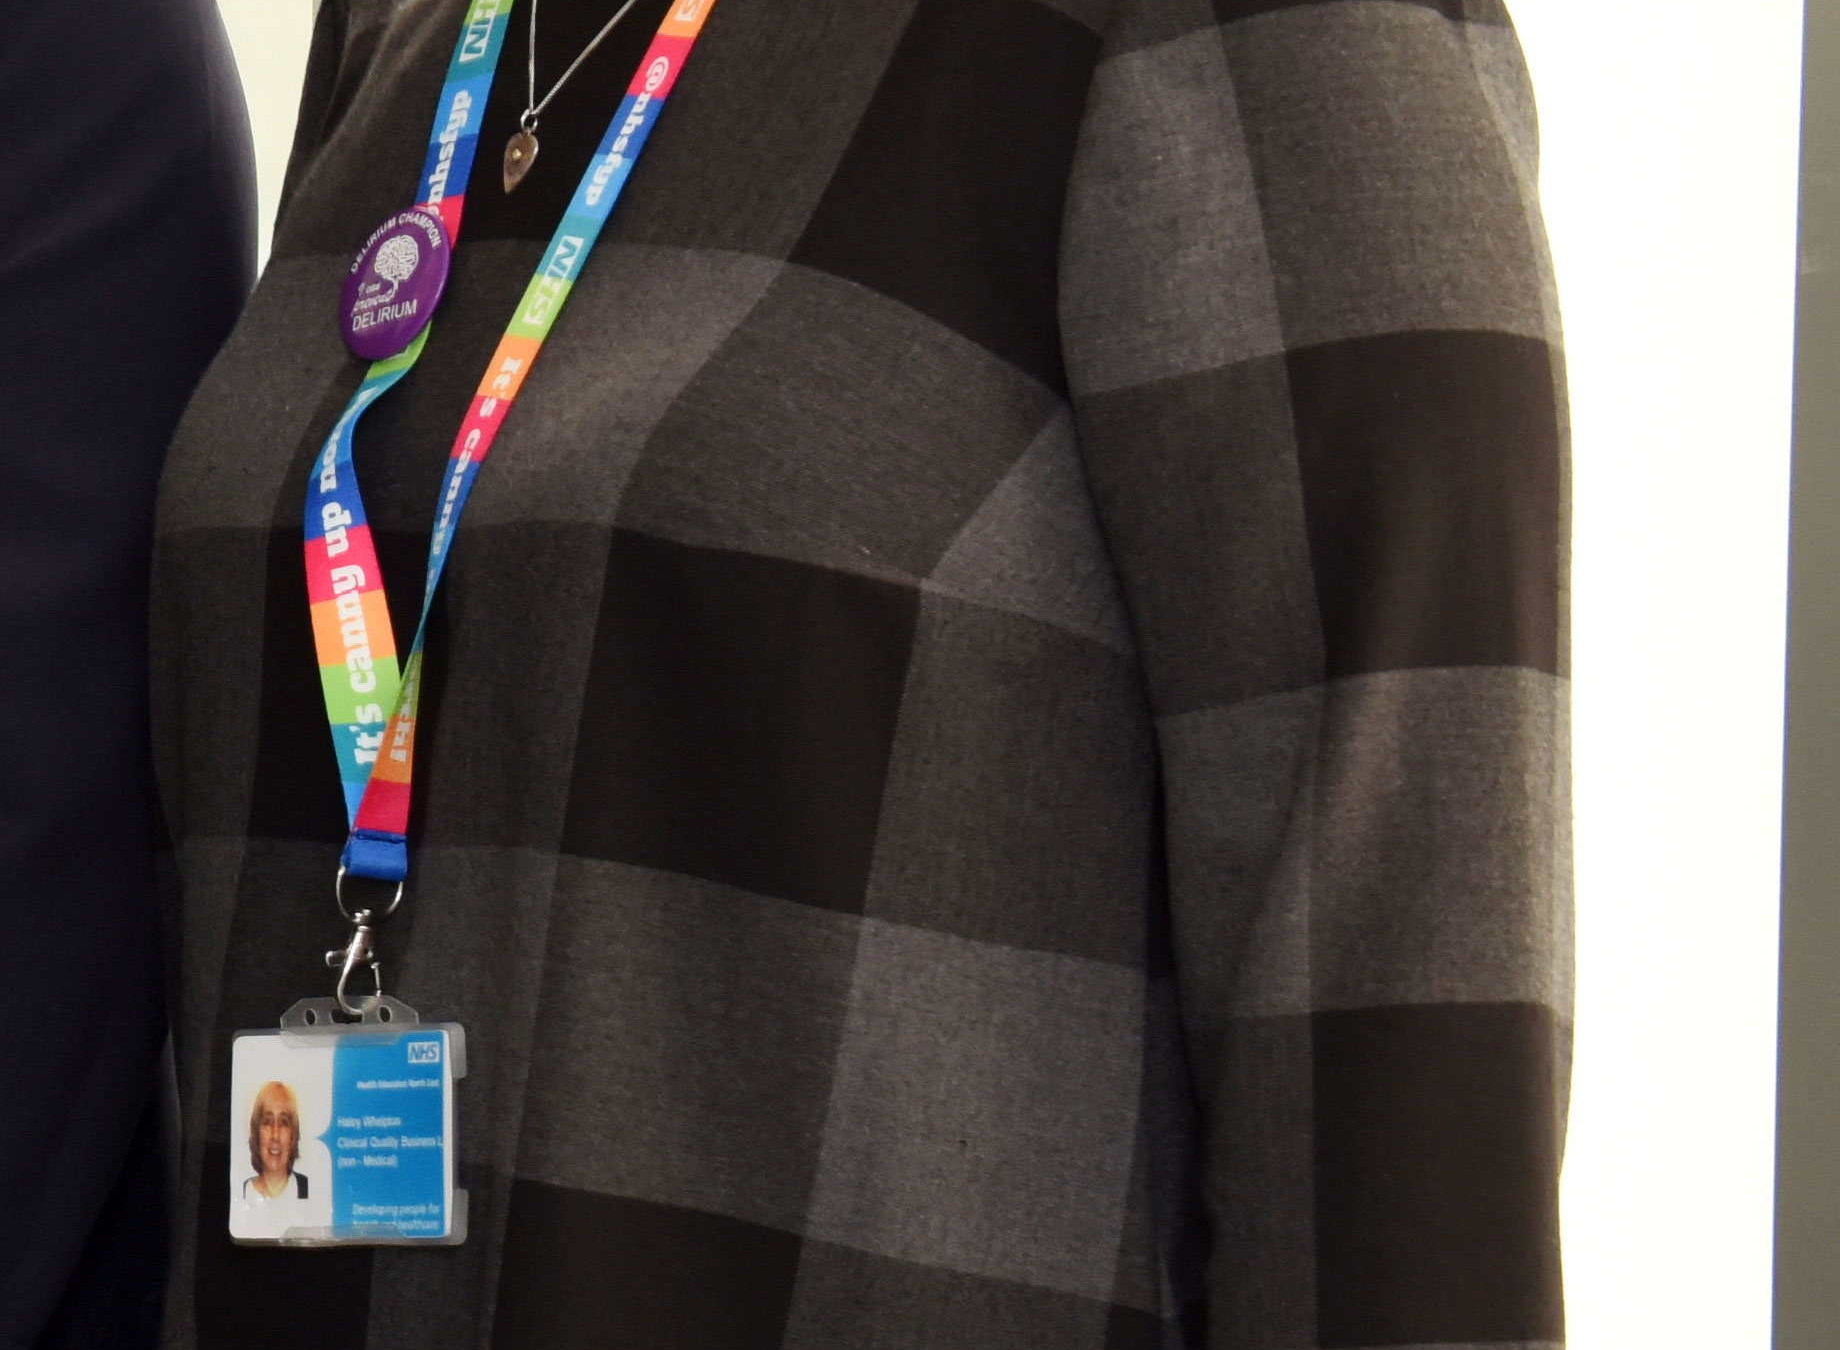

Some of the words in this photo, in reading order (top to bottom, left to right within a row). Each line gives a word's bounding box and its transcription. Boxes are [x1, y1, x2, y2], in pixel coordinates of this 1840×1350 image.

[584, 55, 670, 206] @nhsfyp
[350, 216, 397, 274] DELIRIUM
[398, 212, 442, 250] CHAMPION
[522, 235, 586, 326] NHS
[351, 298, 418, 332] DELIRIUM
[321, 501, 353, 558] up
[330, 564, 378, 694] canny
[349, 702, 385, 766] It's
[409, 1042, 438, 1062] NHS
